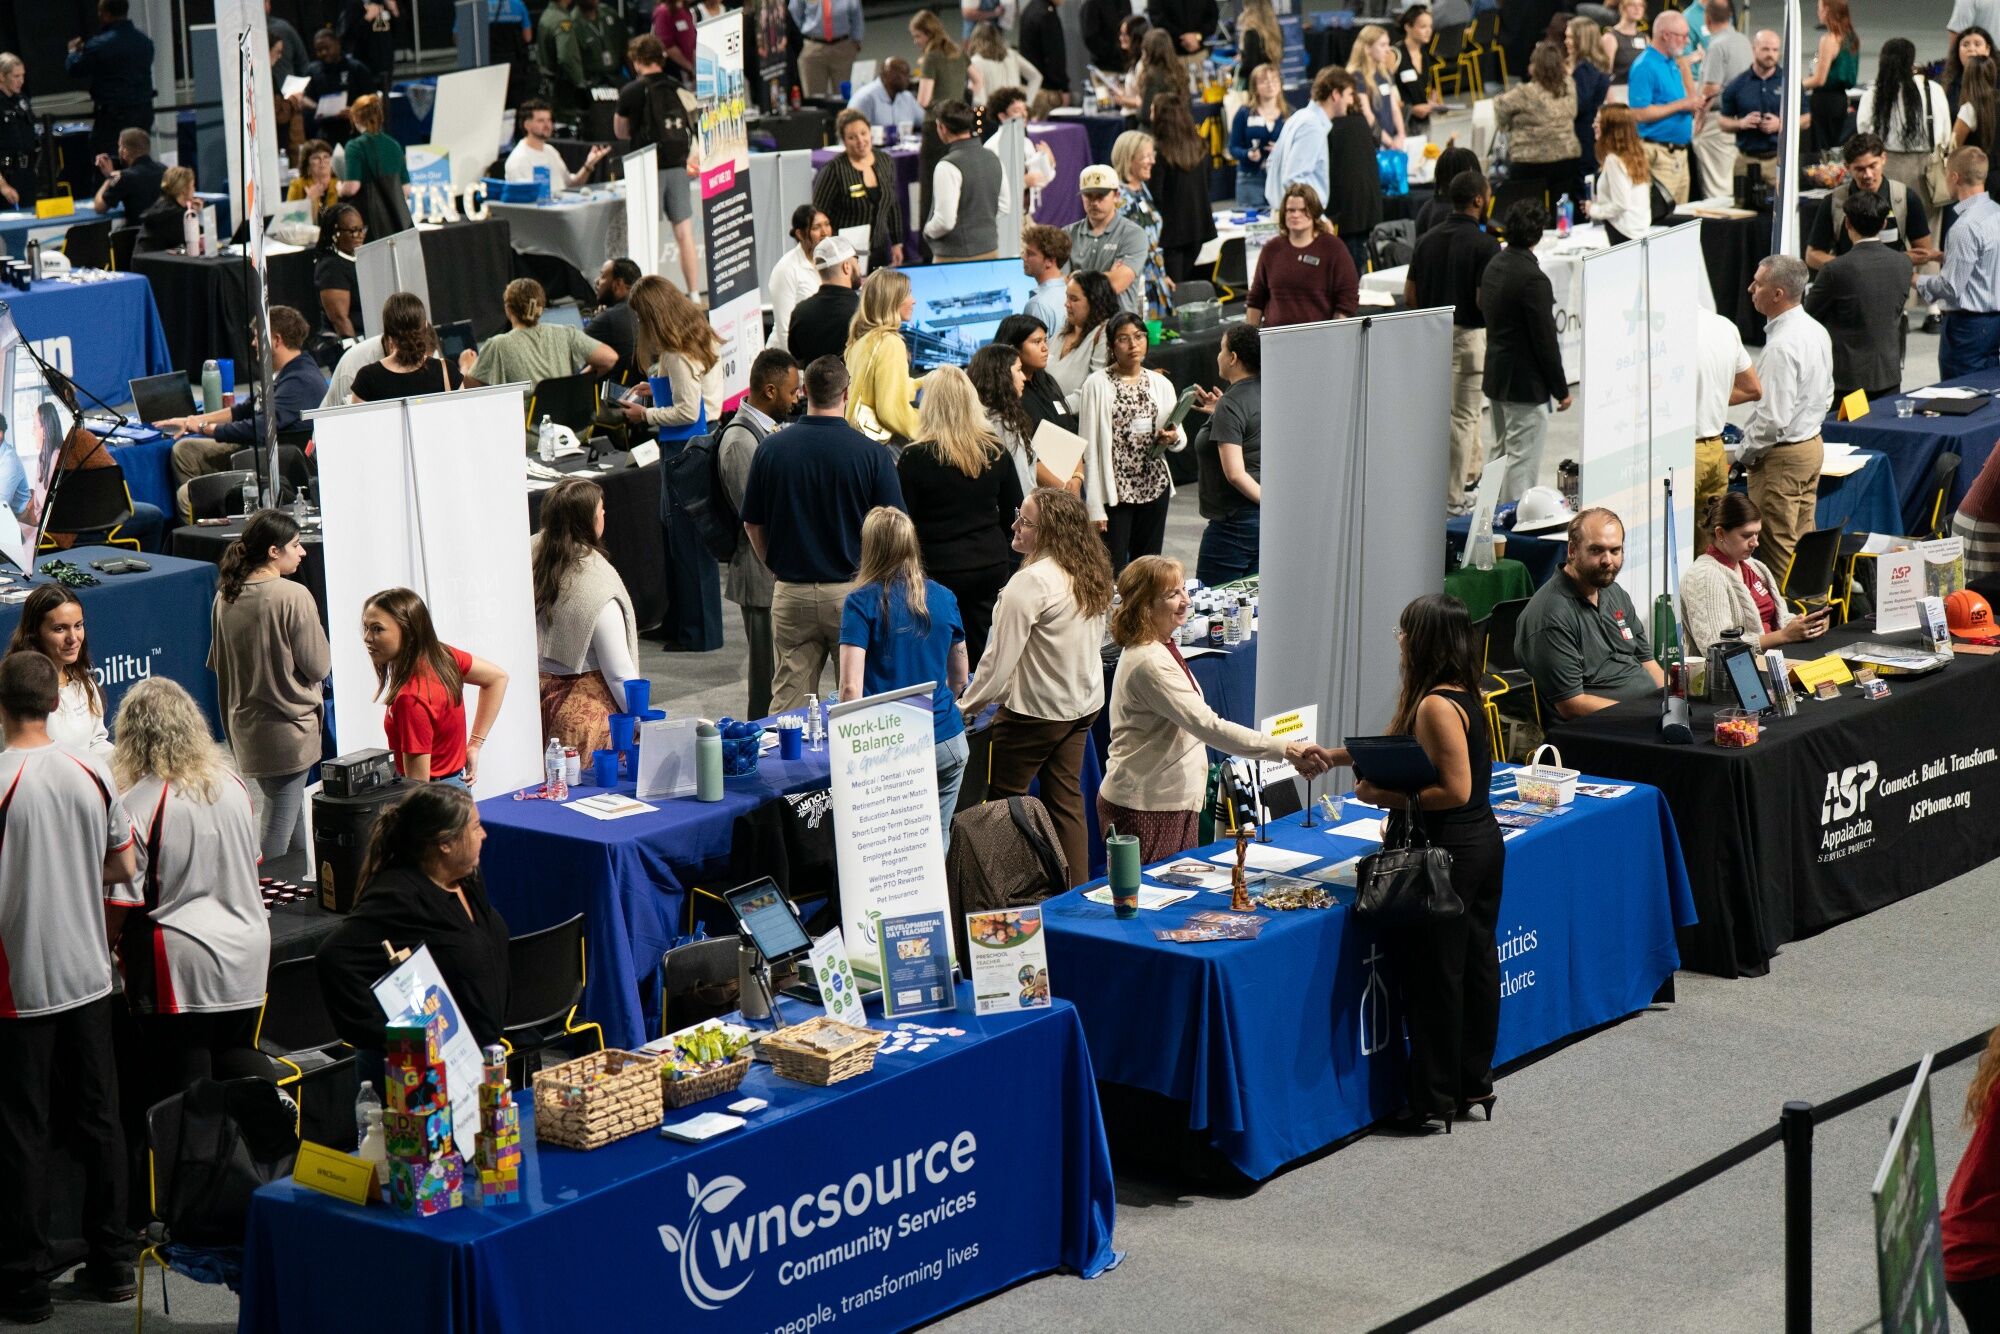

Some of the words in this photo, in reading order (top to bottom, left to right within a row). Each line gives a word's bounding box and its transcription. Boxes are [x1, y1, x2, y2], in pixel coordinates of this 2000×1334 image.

[1891, 566, 1912, 580] ASP
[1970, 609, 1987, 621] ASP
[838, 714, 901, 739] Work-Life
[852, 732, 905, 753] Balance
[851, 778, 876, 789] Medical
[880, 772, 901, 782] Dental
[906, 766, 925, 776] Vision
[1879, 769, 1919, 797] Connect.
[1922, 757, 1948, 782] Build.
[1950, 748, 1998, 772] Transform.
[871, 785, 882, 794] Life
[883, 779, 914, 790] Insurance
[1821, 760, 1878, 826] ASP
[852, 798, 885, 812] Retirement
[887, 794, 901, 803] Plan
[1909, 791, 1970, 823] ASPhome.org
[859, 810, 889, 824] Education
[891, 803, 924, 816] Assistance
[904, 814, 932, 826] Disability
[857, 838, 887, 851] Generous
[888, 834, 901, 844] Paid
[903, 830, 919, 839] Time
[920, 826, 930, 834] Off
[1821, 819, 1872, 850] Appalachia
[863, 850, 892, 863] Employee
[894, 842, 927, 855] Assistance
[881, 855, 908, 867] Program
[1817, 848, 1846, 863] SERVICE
[869, 872, 895, 884] Wellness
[897, 865, 924, 877] Program
[869, 884, 882, 893] with
[883, 881, 897, 890] PTO
[898, 874, 925, 886] Rewards
[877, 895, 887, 904] Pet
[889, 889, 919, 901] Insurance
[885, 919, 941, 932] DEVELOPMENTAL
[886, 931, 900, 939] DAY
[901, 927, 934, 937] TEACHERS
[976, 951, 1008, 960] PRESCHOOL
[977, 958, 1001, 966] TEACHER
[711, 1130, 977, 1269] wncsource
[778, 1224, 892, 1286] Community
[898, 1190, 977, 1238] Services
[841, 1258, 943, 1314] transforming
[947, 1243, 979, 1270] lives
